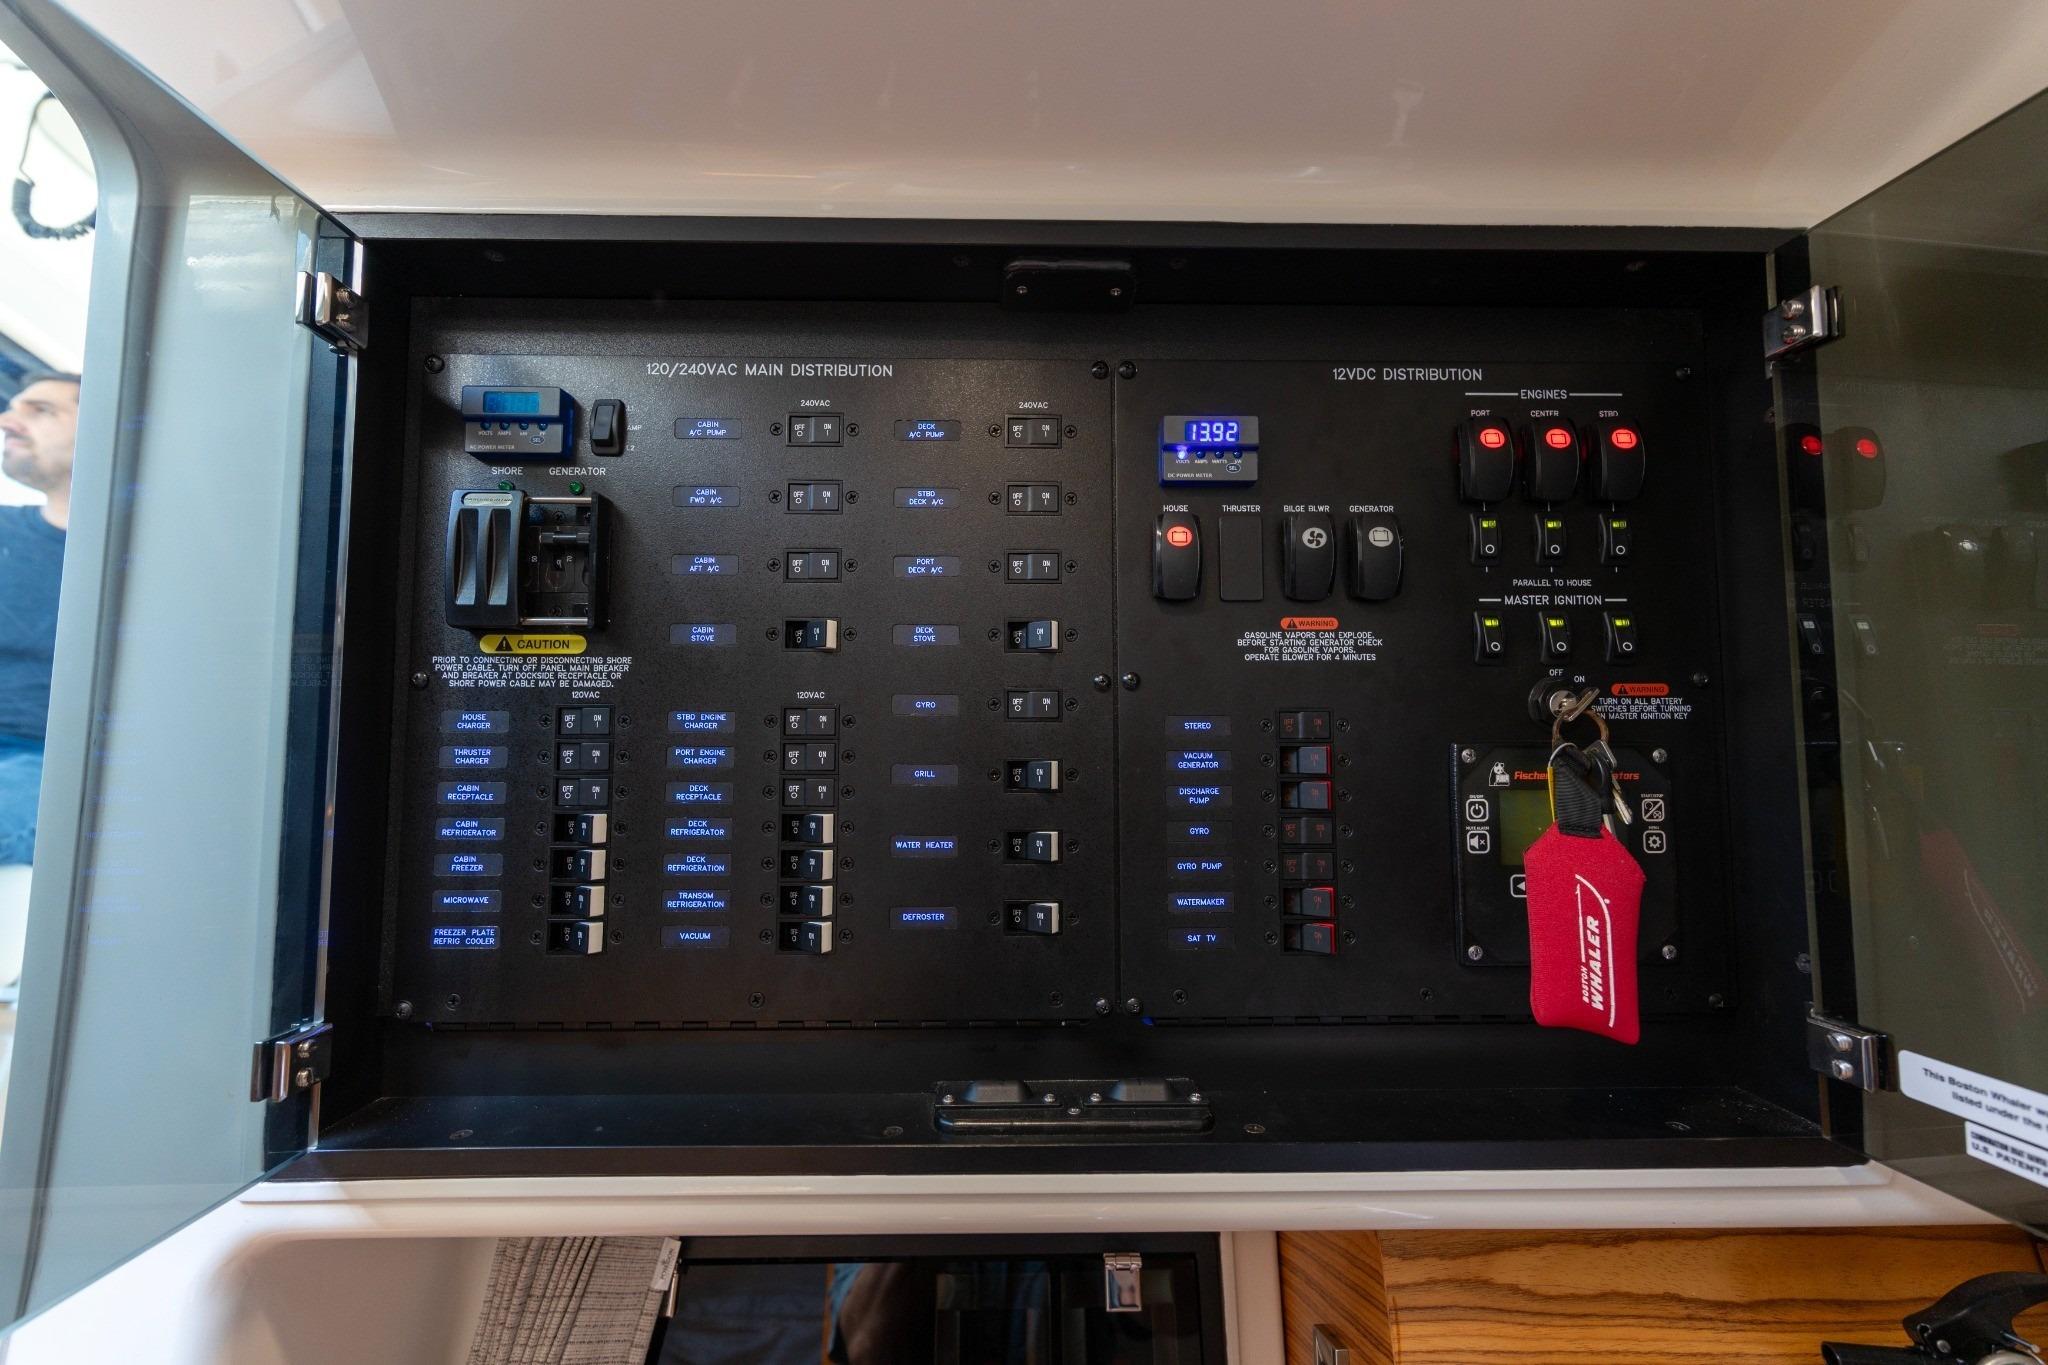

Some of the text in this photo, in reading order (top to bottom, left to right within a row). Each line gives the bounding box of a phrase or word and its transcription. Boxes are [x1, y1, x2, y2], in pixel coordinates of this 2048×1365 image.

[646, 362, 892, 378] 120/240VAC MAIN DISTRIBUTION
[1332, 367, 1482, 381] 12VDC DISTRIBUTION
[1520, 390, 1568, 399] ENGINES
[1018, 401, 1048, 409] 240VAC
[688, 429, 702, 437] A/C
[1192, 422, 1238, 442] 13.92
[490, 466, 523, 476] SHORE
[549, 466, 606, 476] GENERATOR
[710, 496, 722, 505] A/C
[1222, 504, 1261, 512] THRUSTER
[1283, 504, 1305, 513] BILGE
[707, 565, 719, 573] A/C
[930, 566, 943, 574] A/C
[1512, 578, 1551, 587] PARALLEL
[1566, 579, 1592, 587] HOUSE
[1504, 595, 1602, 605] MASTER IGNITION
[1244, 631, 1375, 640] GASOLINE VAPORS CAN EXPLODE.
[517, 640, 570, 649] CAUTION
[1237, 638, 1266, 647] BEFORE
[1270, 638, 1306, 647] STARTING
[1309, 638, 1354, 647] GENERATOR
[432, 656, 632, 665] PRIOR TO CONNECTING OR DISCONNECTING SHORE
[1244, 653, 1279, 661] OPERATE
[1282, 653, 1314, 661] BLOWER
[435, 664, 463, 673] POWER
[498, 664, 519, 673] TURN
[522, 664, 537, 673] OFF
[540, 664, 566, 673] PANEL
[570, 664, 590, 673] MAIN
[594, 664, 629, 673] BREAKER
[1549, 668, 1564, 677] OFF
[442, 672, 622, 680] AND BREAKER AT DOCKSIDE RECEPTACLE OR
[448, 679, 614, 688] SHORE POWER CABLE MAY BE DAMAGED.
[572, 690, 600, 699] 120VAC
[447, 792, 494, 801] RECEPTACLE
[442, 828, 496, 837] REFRIGERATOR
[1177, 862, 1197, 870] GYRO
[902, 913, 944, 921] DEFROSTER
[434, 928, 494, 936] FREEZER PLATE
[1187, 934, 1201, 942] SAT
[1586, 916, 1604, 1010] WHALER
[1580, 966, 1590, 1004] BOSTON
[1948, 1076, 2032, 1110] Boston Whaler
